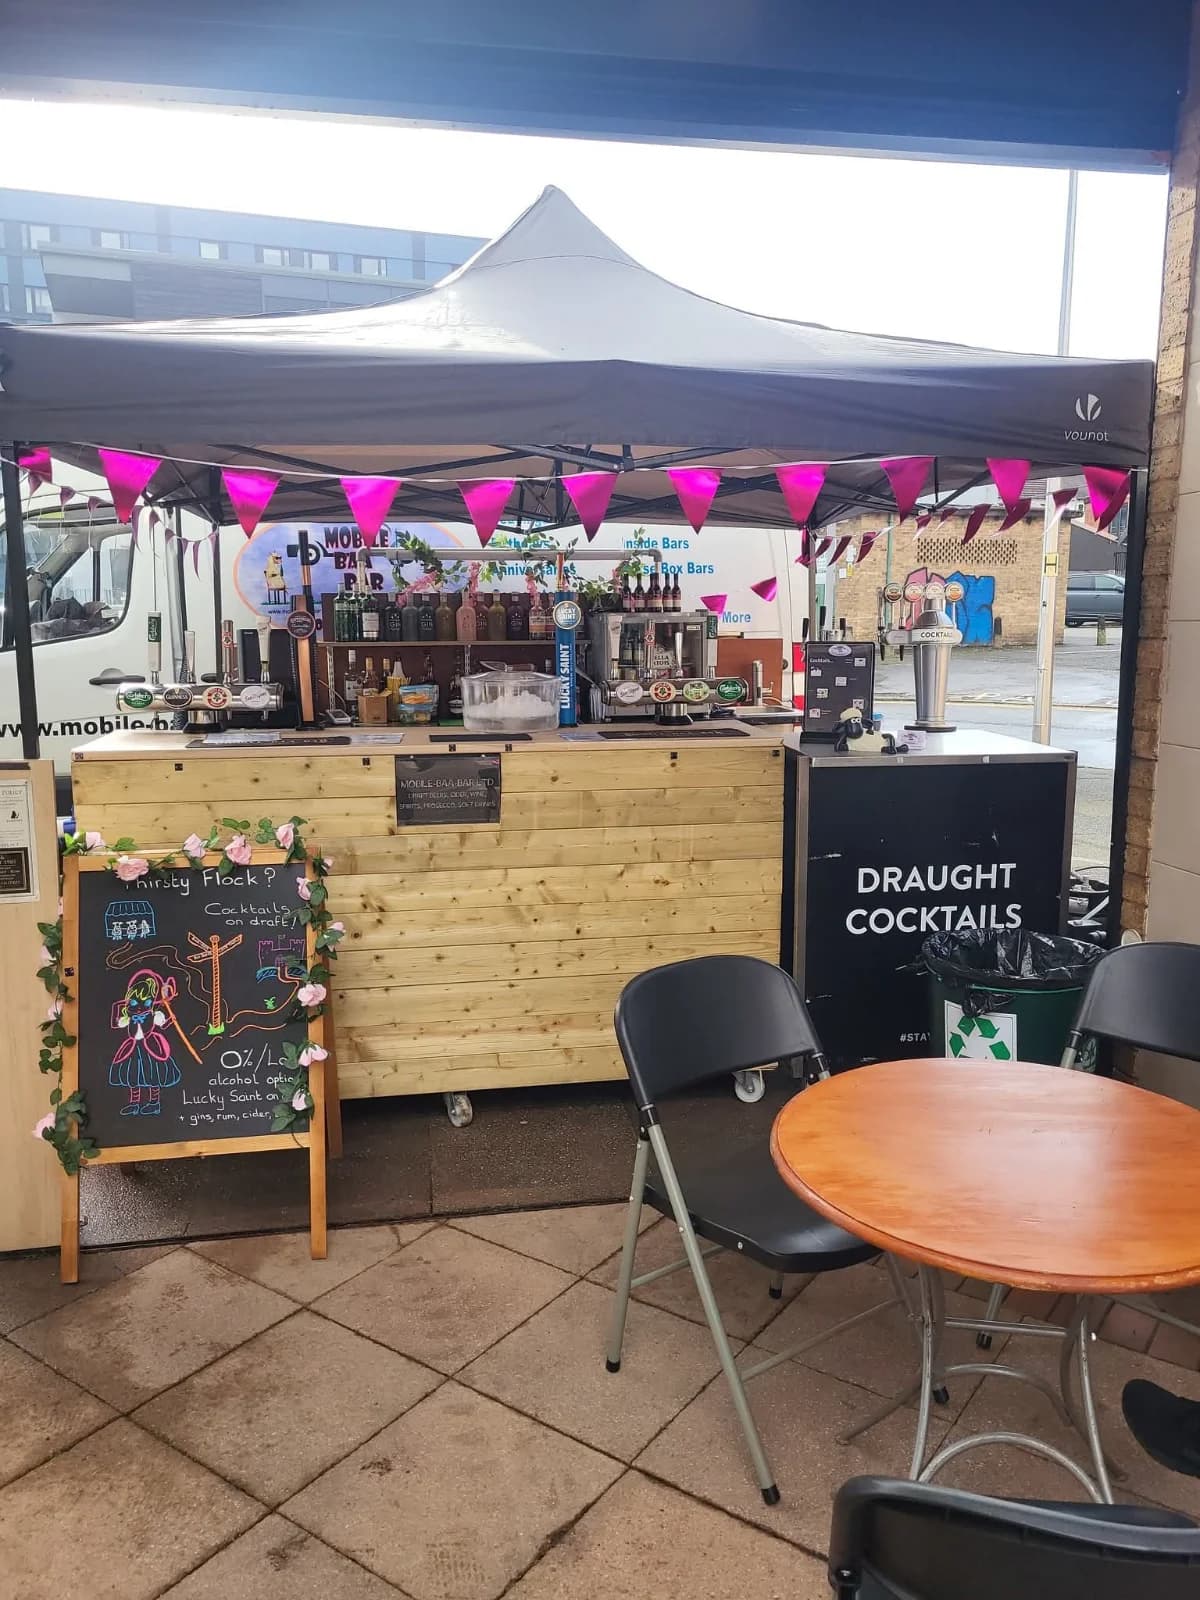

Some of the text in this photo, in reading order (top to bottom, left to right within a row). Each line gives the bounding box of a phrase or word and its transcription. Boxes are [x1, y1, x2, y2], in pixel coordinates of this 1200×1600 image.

[324, 526, 389, 549] MOBLE
[662, 537, 689, 549] Bars
[661, 562, 683, 574] Box
[687, 562, 714, 574] Bars
[722, 611, 751, 623] More
[559, 643, 570, 709] LUCKY SAINT
[125, 872, 190, 896] hirsty
[203, 867, 258, 887] Flock
[857, 862, 1017, 894] DRAUGHT
[204, 902, 291, 916] Cocktails
[250, 915, 296, 930] draft!
[846, 903, 1022, 935] COCKTAILS
[209, 1072, 259, 1086] alcohol
[182, 1089, 225, 1110] Lucky
[230, 1089, 262, 1102] Saint
[190, 1112, 214, 1126] gins,
[242, 1108, 272, 1120] cider,
